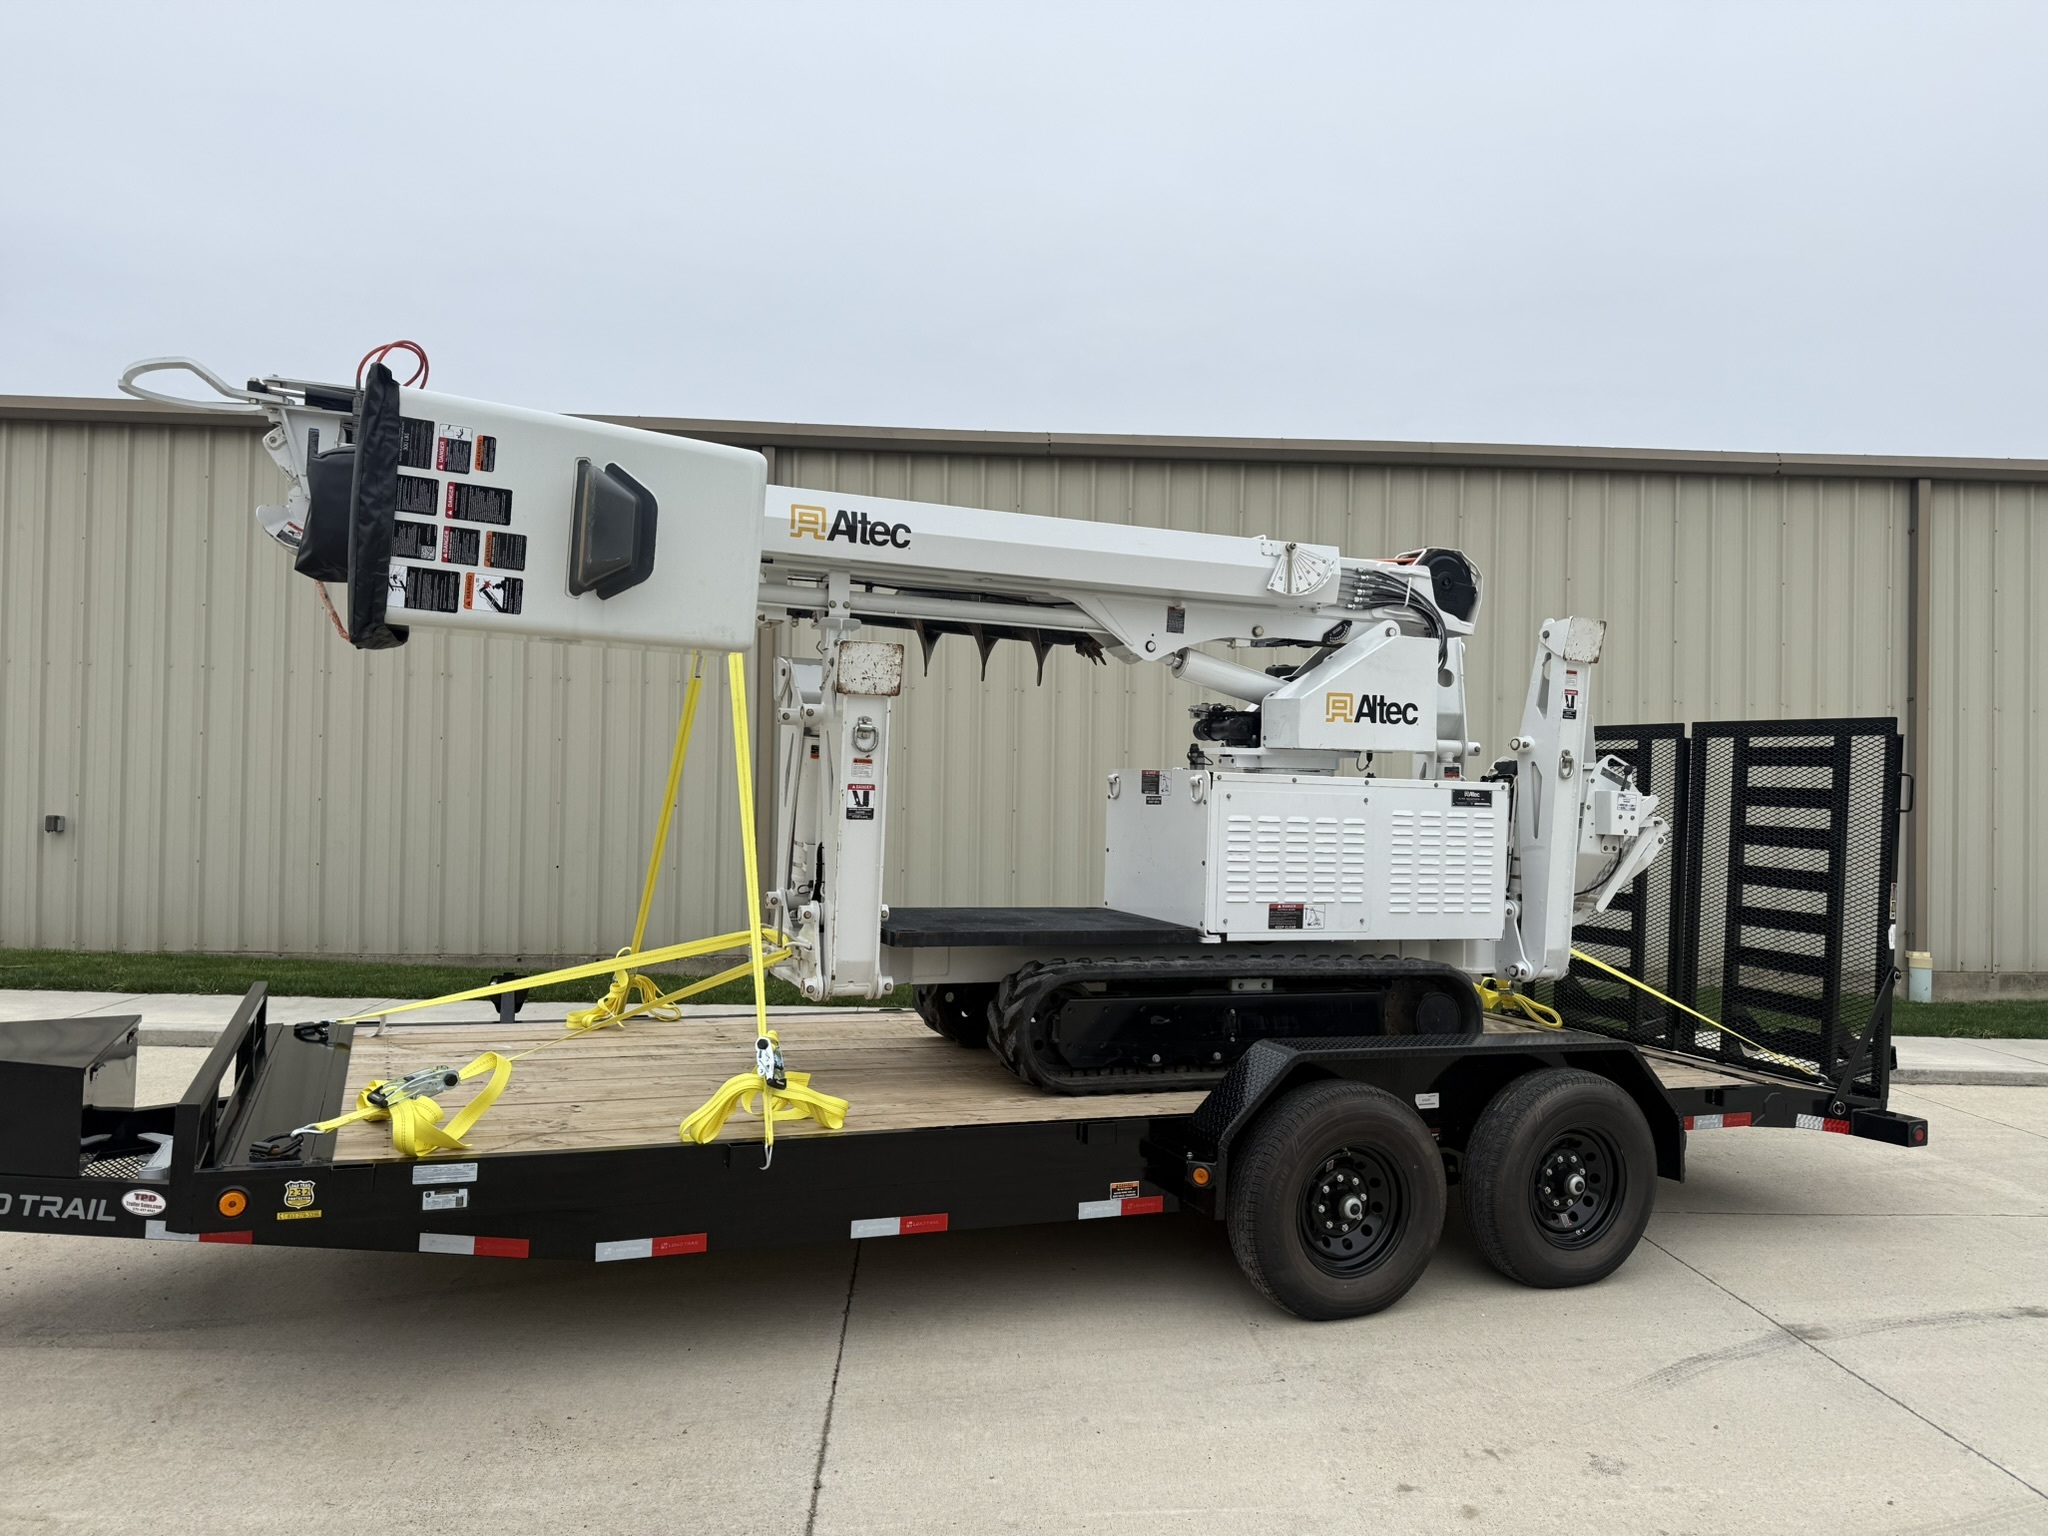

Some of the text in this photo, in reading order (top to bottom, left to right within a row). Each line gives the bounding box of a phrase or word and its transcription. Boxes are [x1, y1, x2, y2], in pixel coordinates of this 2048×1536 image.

[827, 509, 912, 549] Altec
[1354, 694, 1419, 726] Altec
[134, 1193, 157, 1202] TPD
[290, 1188, 309, 1196] 232
[19, 1194, 117, 1222] TRAIL
